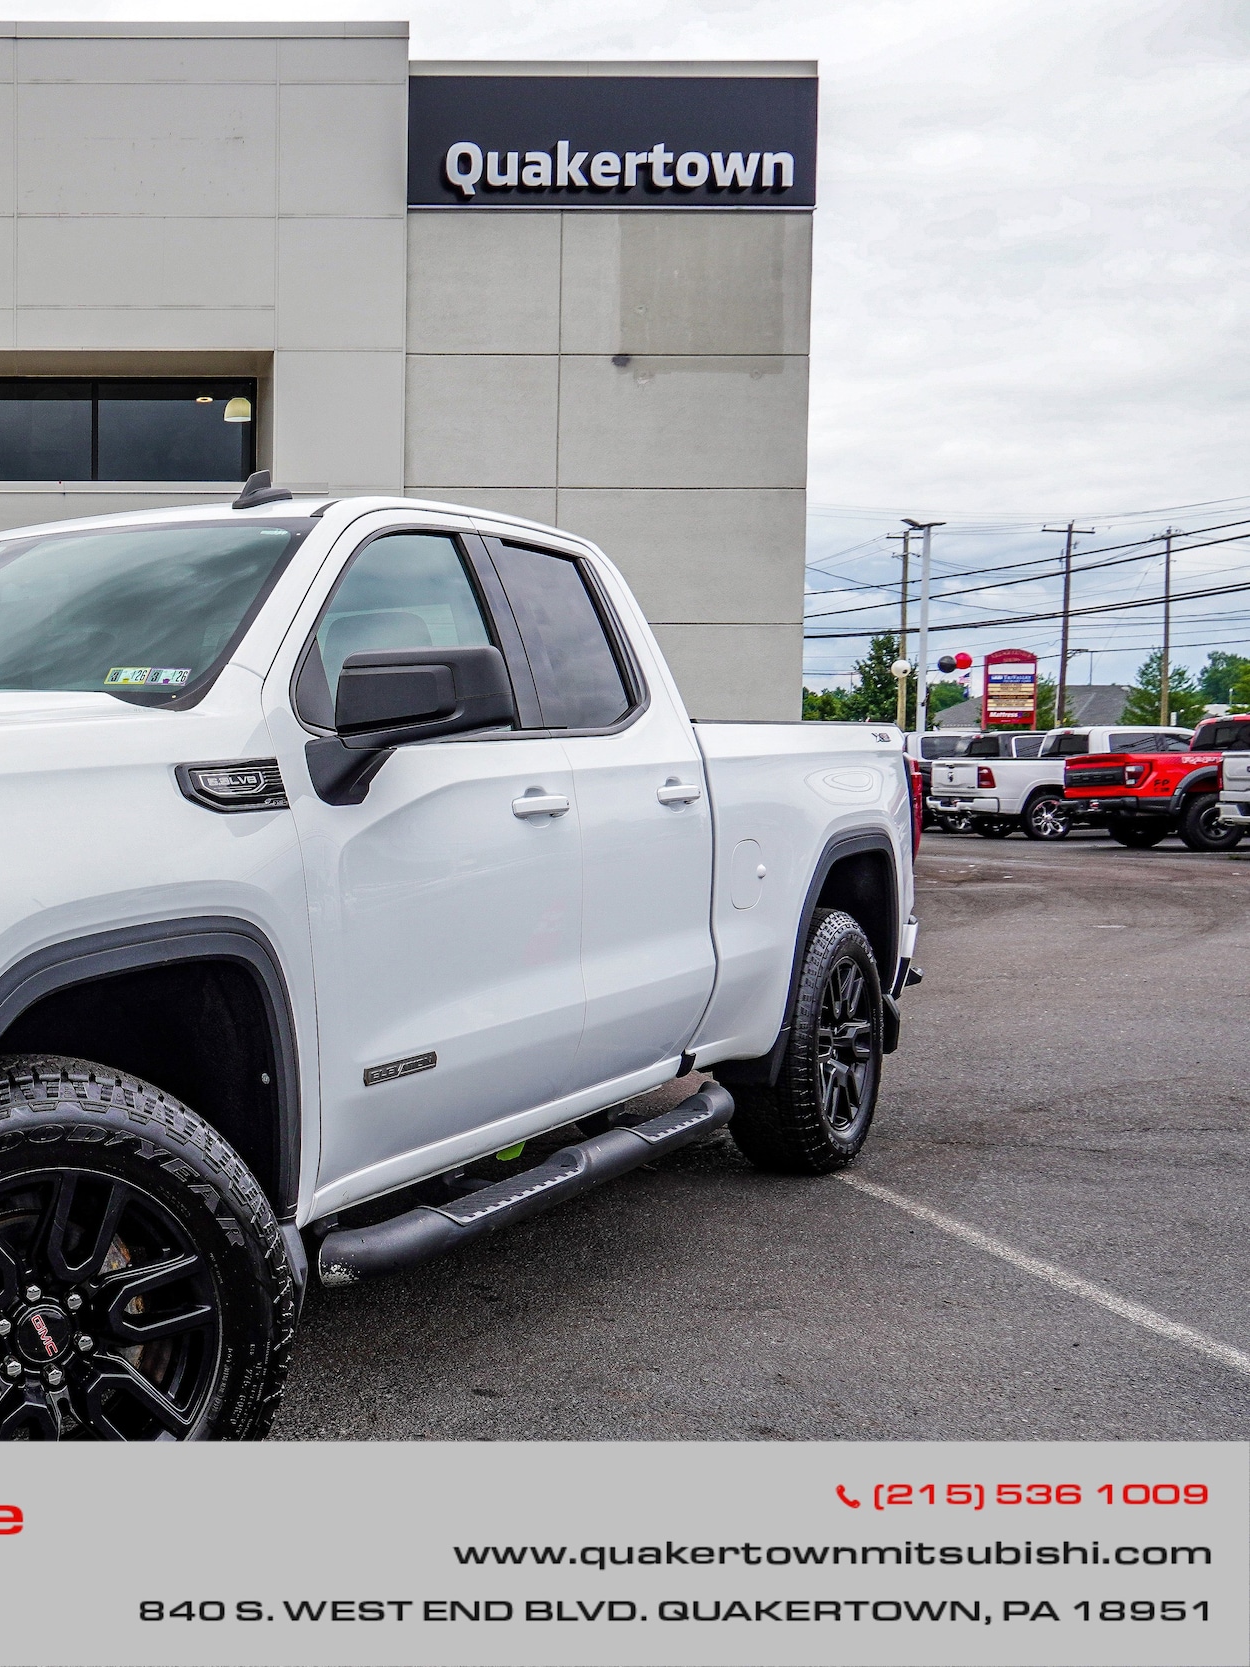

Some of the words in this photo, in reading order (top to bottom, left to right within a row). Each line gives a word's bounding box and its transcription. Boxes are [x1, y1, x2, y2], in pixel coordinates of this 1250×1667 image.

[445, 140, 795, 196] Quakertown
[135, 669, 148, 682] 26
[175, 670, 188, 683] 26
[31, 1314, 59, 1357] GMC
